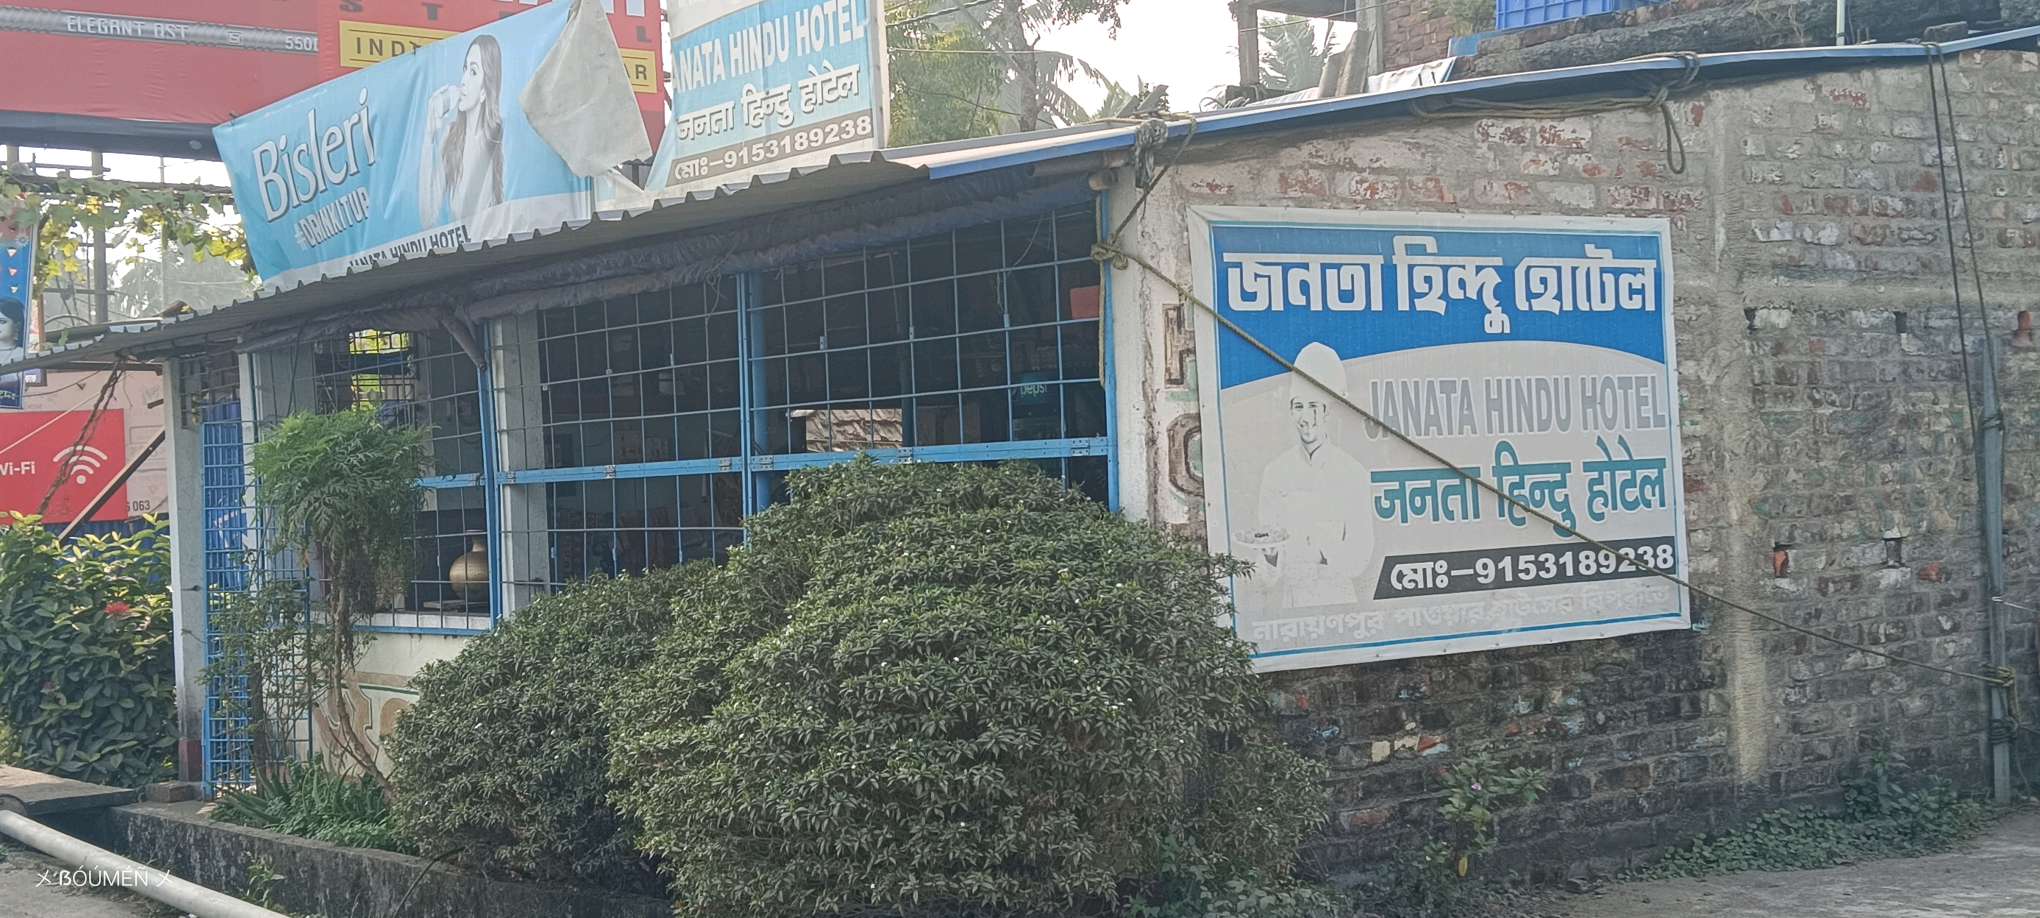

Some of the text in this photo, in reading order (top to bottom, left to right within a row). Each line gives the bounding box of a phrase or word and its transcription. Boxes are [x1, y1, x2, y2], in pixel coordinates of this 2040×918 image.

[66, 15, 146, 37] ELEGANT
[729, 15, 790, 78] HINDU
[795, 0, 865, 57] HOTEL
[252, 87, 376, 224] Bisleri
[677, 100, 736, 141] जनता
[429, 224, 472, 250] HOTEL
[1222, 235, 1657, 334] জনতা হিন্দু হোটেল
[1364, 374, 1667, 440] JANATA HINDU HOTEL
[1370, 435, 1667, 538] जनता हिन्दु होटेल
